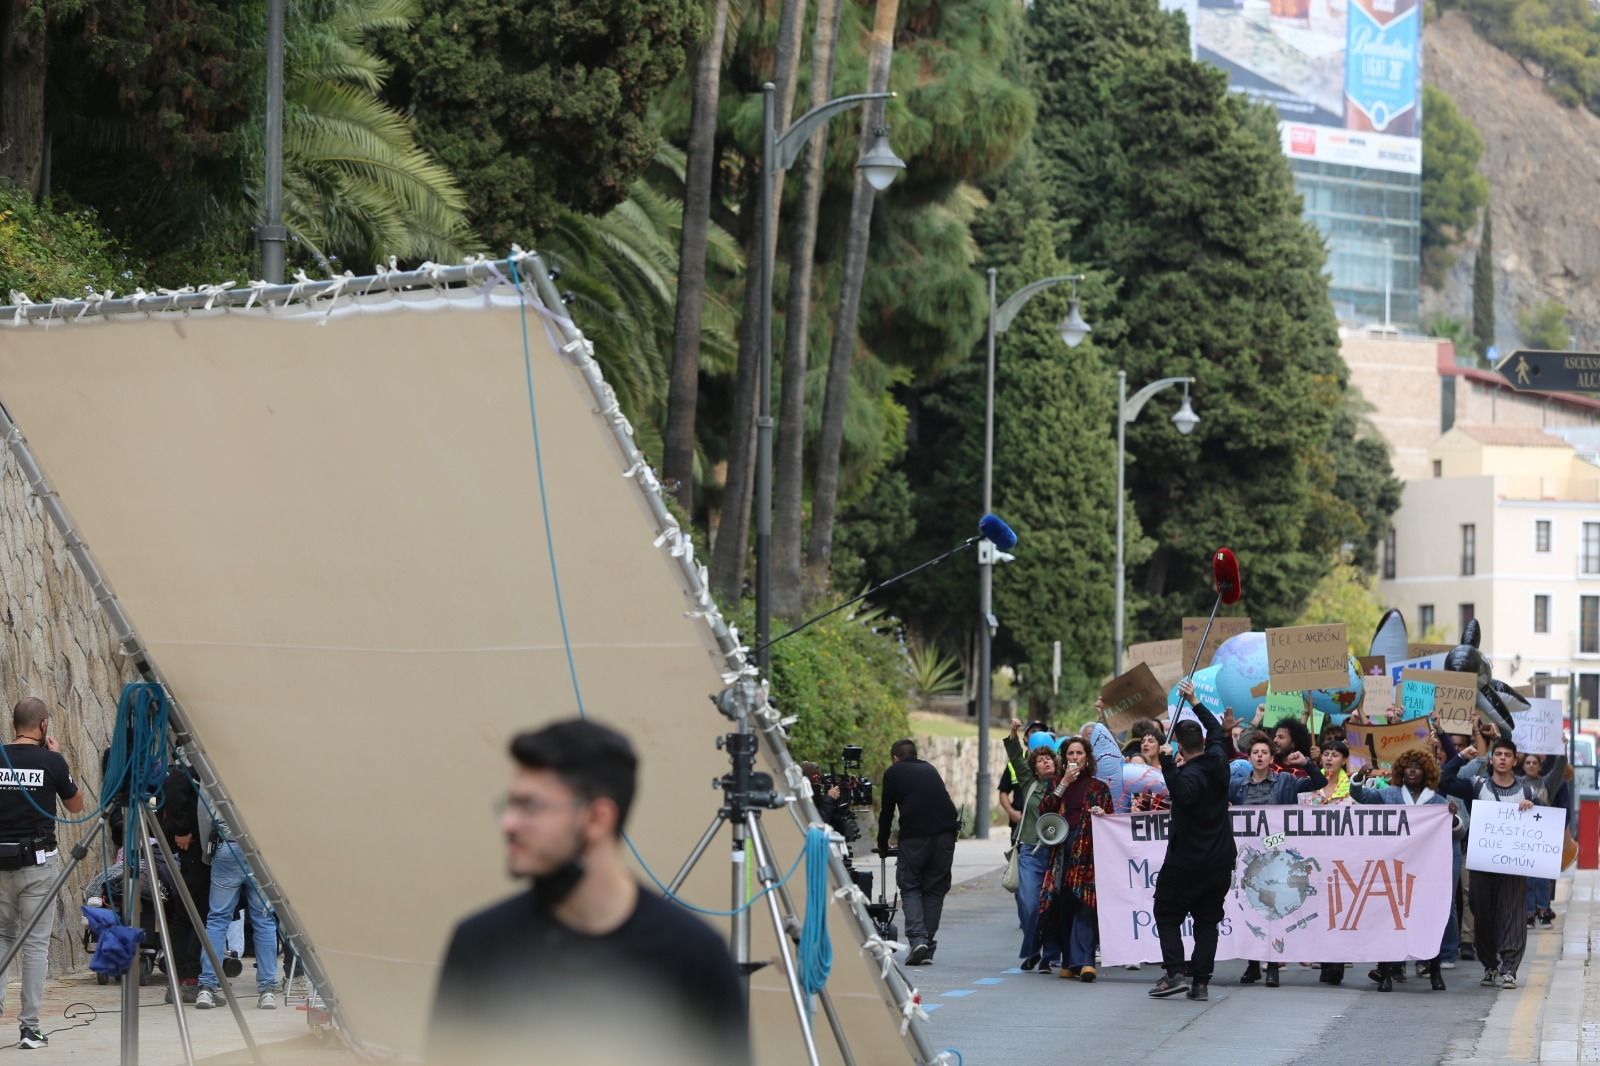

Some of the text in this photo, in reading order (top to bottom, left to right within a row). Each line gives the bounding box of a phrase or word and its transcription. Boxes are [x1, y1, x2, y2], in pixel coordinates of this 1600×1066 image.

[1273, 658, 1307, 674] GRAN
[1406, 682, 1418, 693] NO
[1404, 697, 1425, 711] PLAN
[29, 772, 41, 783] FX
[1284, 806, 1410, 837] CLIMÁTICA
[1484, 821, 1543, 841] PLÁSTICO
[1265, 832, 1285, 848] SOS
[1491, 854, 1536, 869] COMÚN
